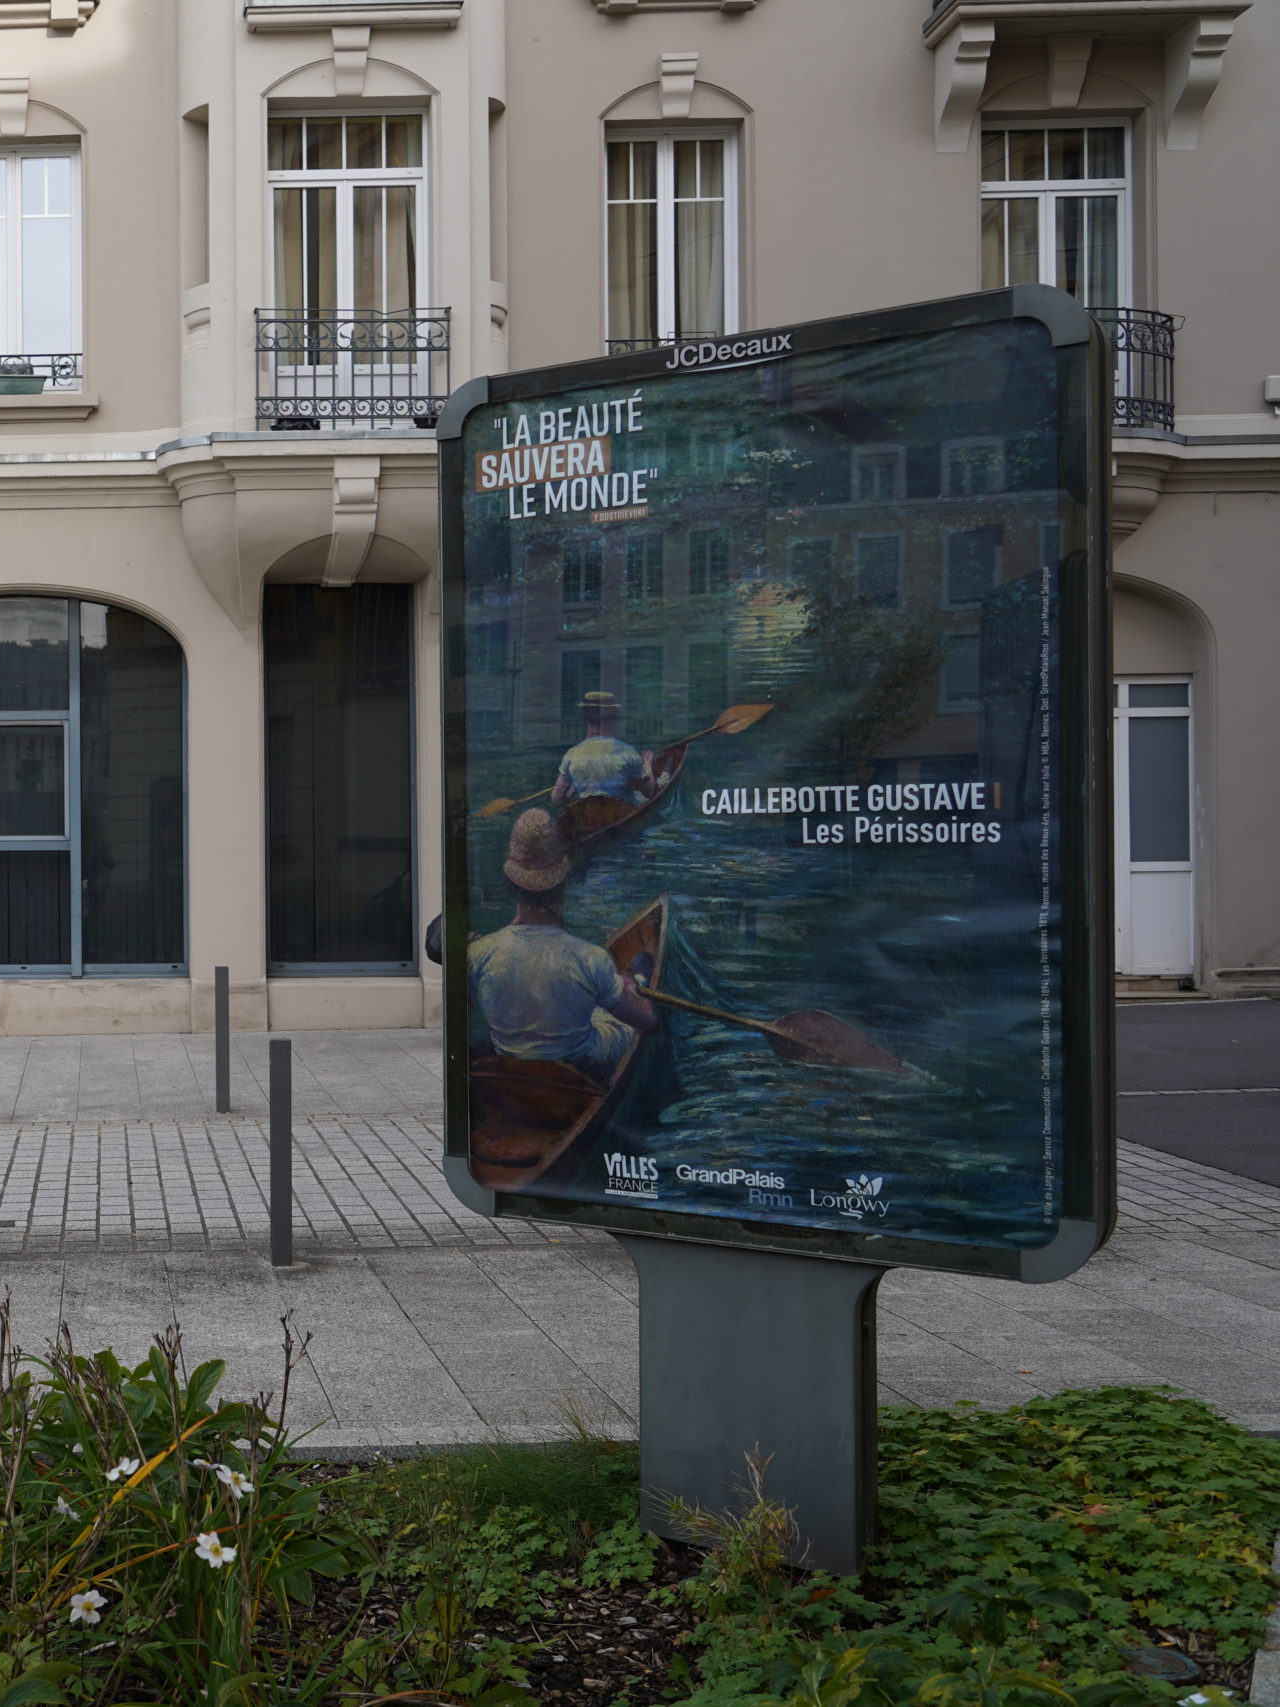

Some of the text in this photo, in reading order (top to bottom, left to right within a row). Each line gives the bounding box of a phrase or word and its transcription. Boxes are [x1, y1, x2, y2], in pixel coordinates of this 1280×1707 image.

[665, 333, 793, 369] JCDecaux
[494, 388, 643, 450] "LA BEAUTÉ
[481, 439, 605, 489] SAUVERA
[509, 467, 658, 520] LE MONDE"
[1040, 566, 1051, 594] Salingue
[1040, 595, 1050, 636] Jean-Manuel
[1040, 643, 1049, 695] GrandPalaisRmn
[1041, 765, 1050, 780] toile
[701, 782, 986, 815] CAILLEBOTTE GUSTAVE
[1042, 781, 1050, 792] sur
[1040, 793, 1050, 809] huile
[802, 815, 1001, 844] Les Périssoires
[1040, 849, 1049, 861] des
[1040, 964, 1050, 976] Les
[1040, 1019, 1050, 1045] Gustave
[1040, 1046, 1050, 1080] Caillebotte
[1041, 1086, 1052, 1135] Communication
[1042, 1136, 1052, 1160] Service
[608, 1177, 659, 1194] FRANCE
[676, 1164, 785, 1190] GrandPalais
[1043, 1166, 1054, 1191] Longwy
[748, 1188, 793, 1208] Rmn
[810, 1188, 890, 1220] Longwy
[1043, 1192, 1052, 1201] de
[1043, 1202, 1053, 1216] Ville
